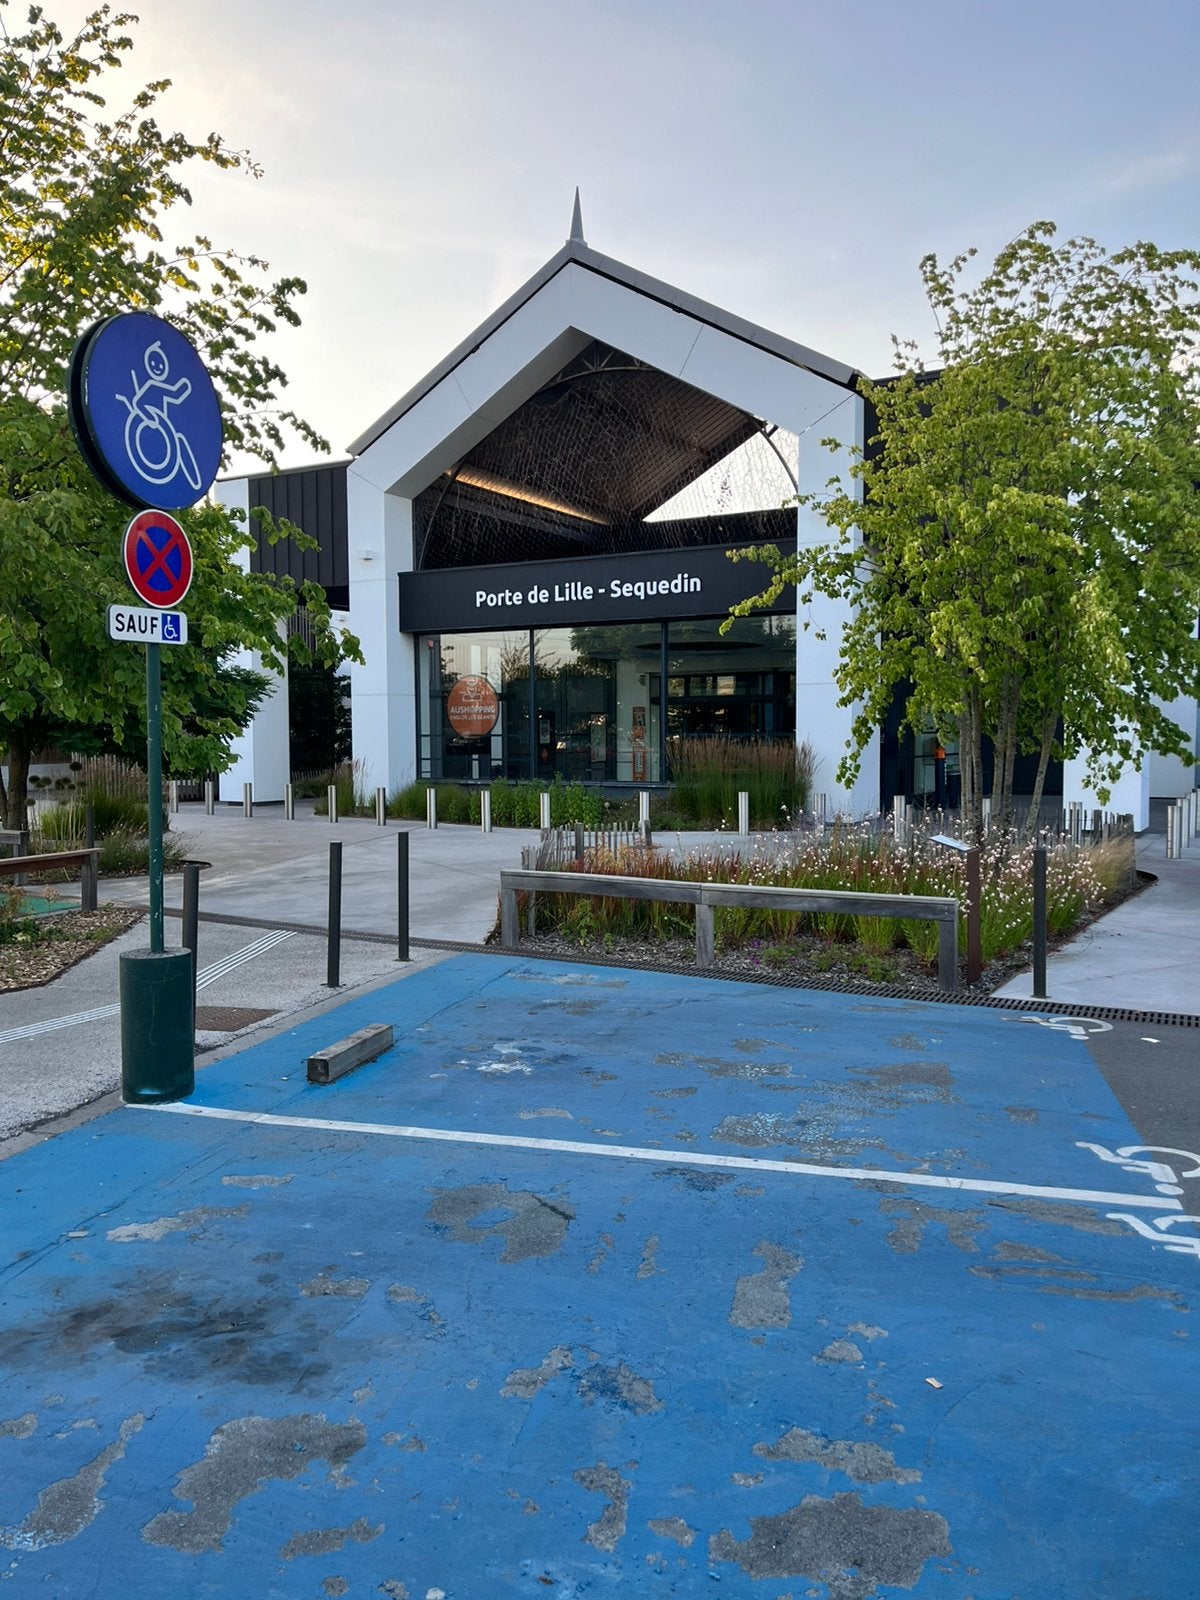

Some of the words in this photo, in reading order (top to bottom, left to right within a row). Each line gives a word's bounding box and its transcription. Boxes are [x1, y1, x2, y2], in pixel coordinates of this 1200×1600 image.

[475, 590, 523, 607] Porte
[527, 585, 549, 603] de
[554, 581, 594, 602] Lille
[610, 573, 702, 600] Sequedin
[115, 613, 159, 634] SAUF
[450, 705, 496, 713] AUSHOPPING
